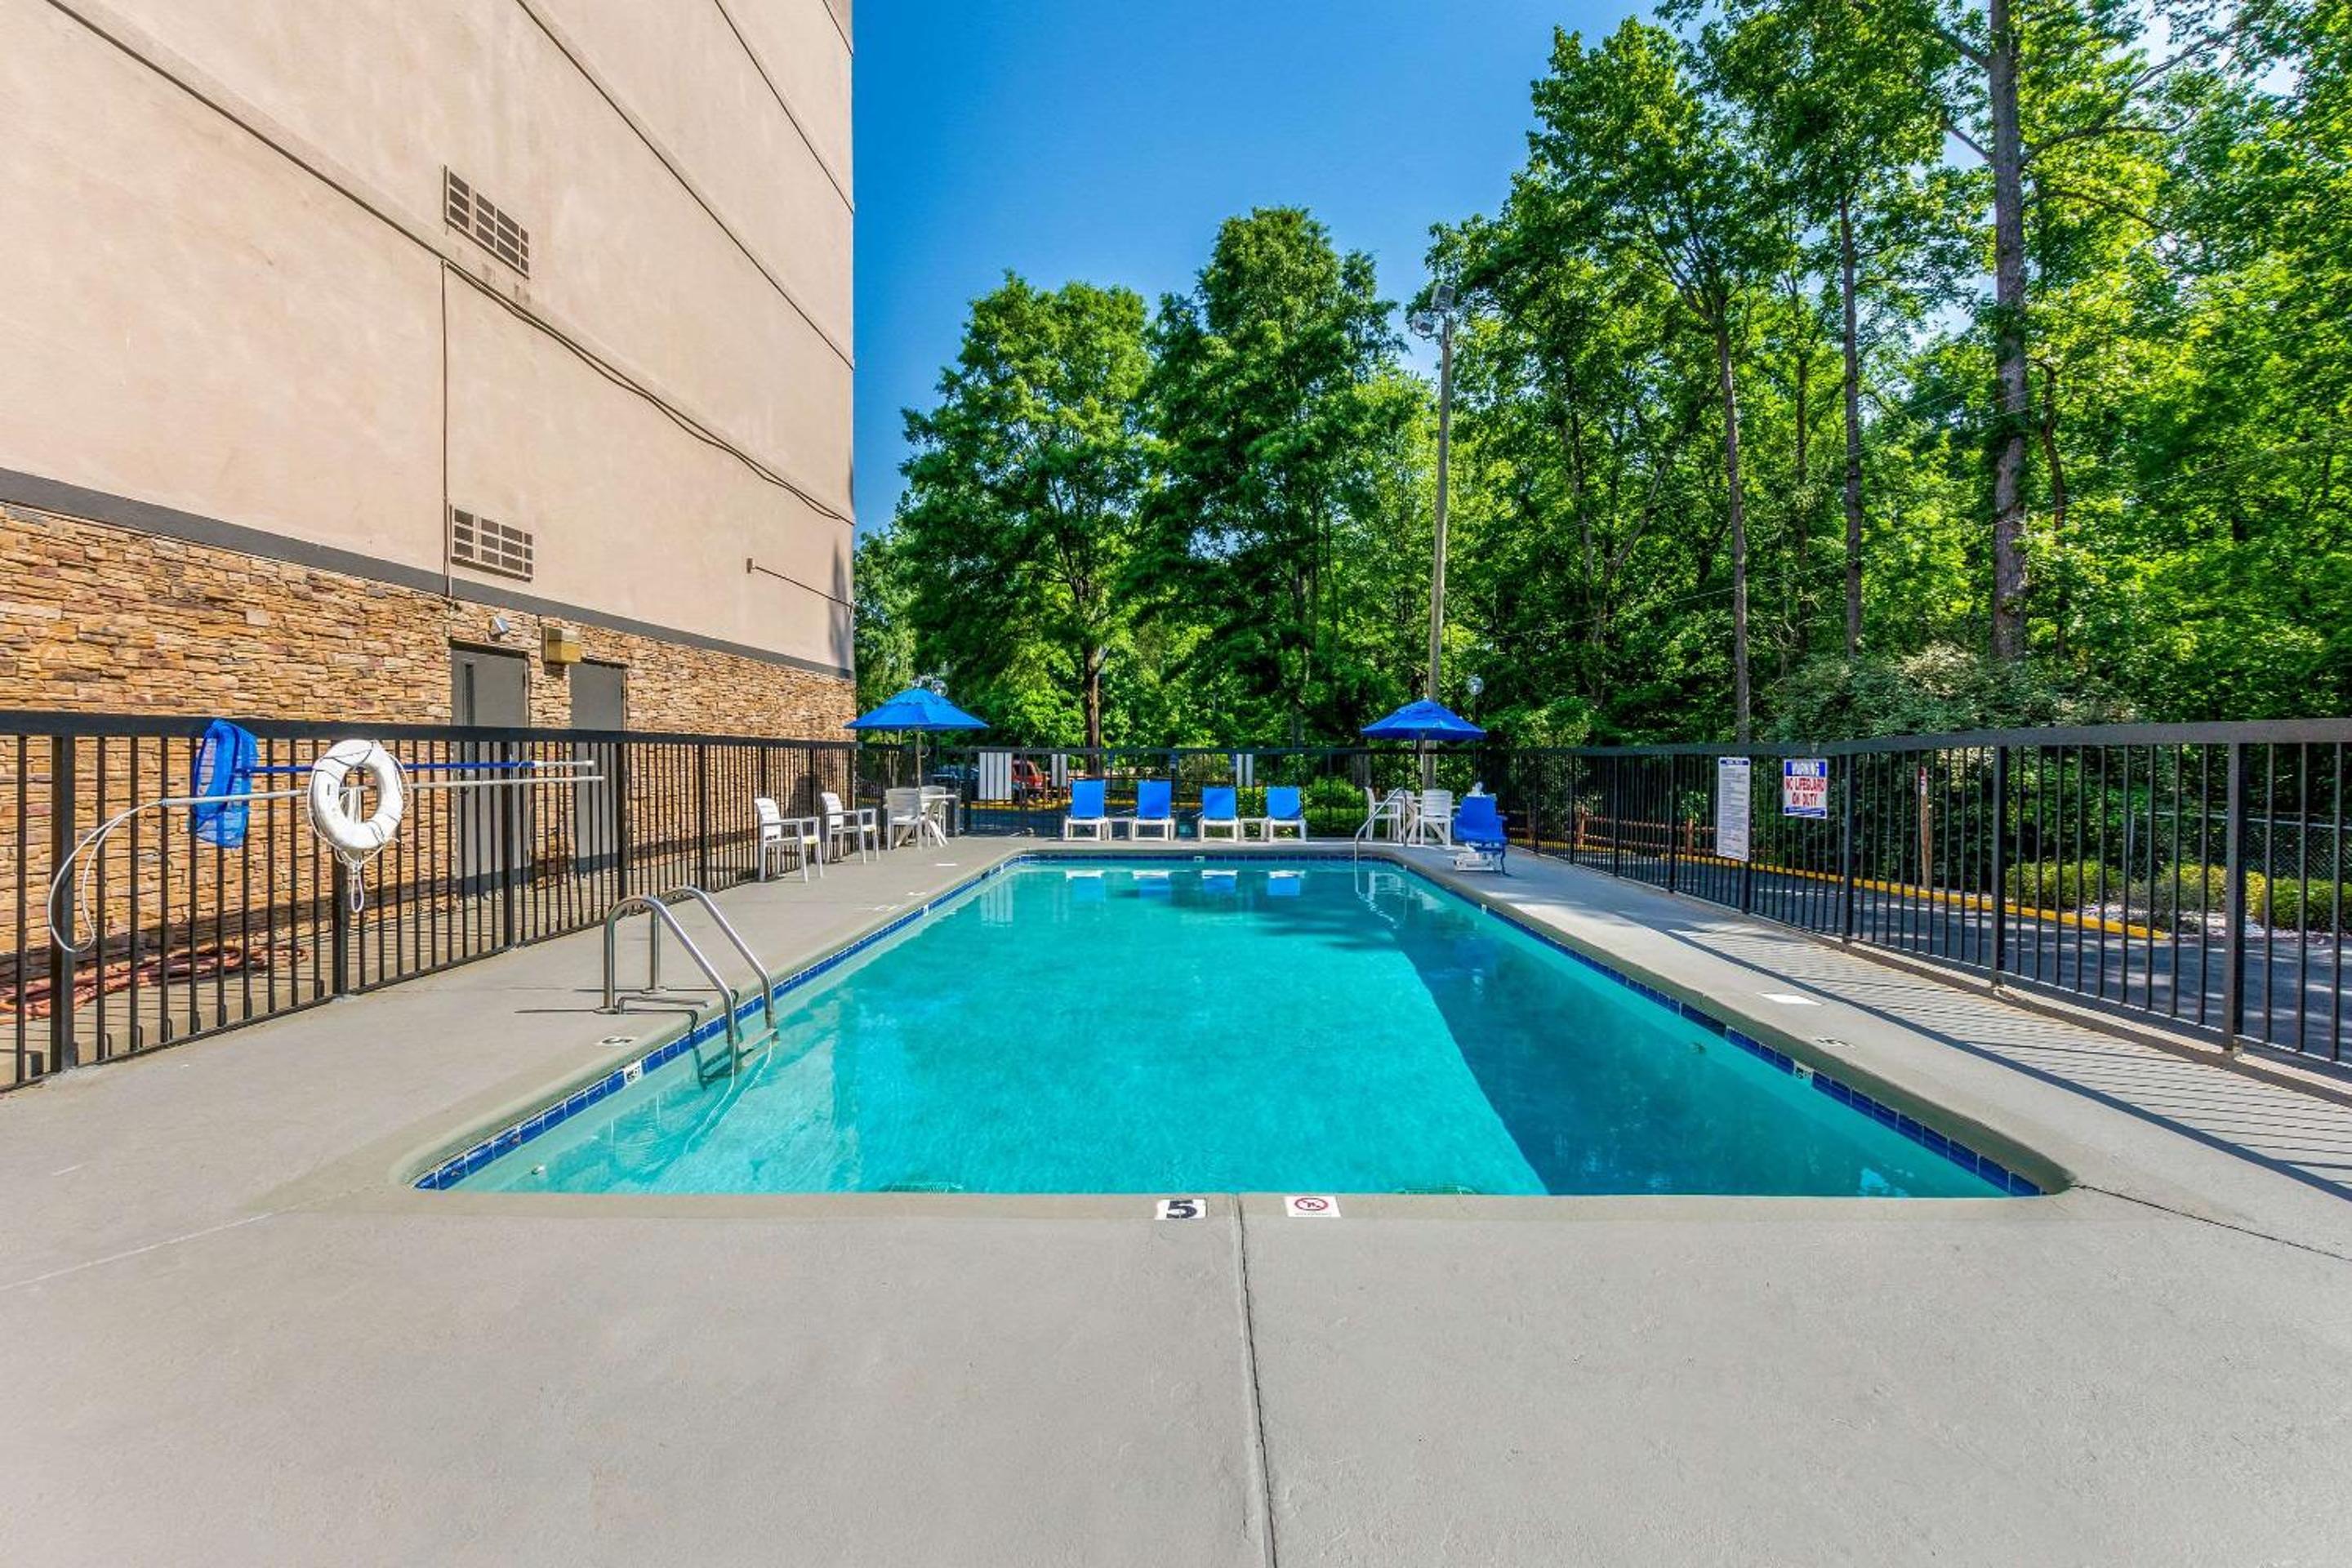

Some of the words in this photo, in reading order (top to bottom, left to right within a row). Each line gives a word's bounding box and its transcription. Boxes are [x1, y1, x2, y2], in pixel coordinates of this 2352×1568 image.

[1785, 777, 1793, 790] NO
[1802, 792, 1819, 806] DUTY
[1166, 1200, 1198, 1219] 5
